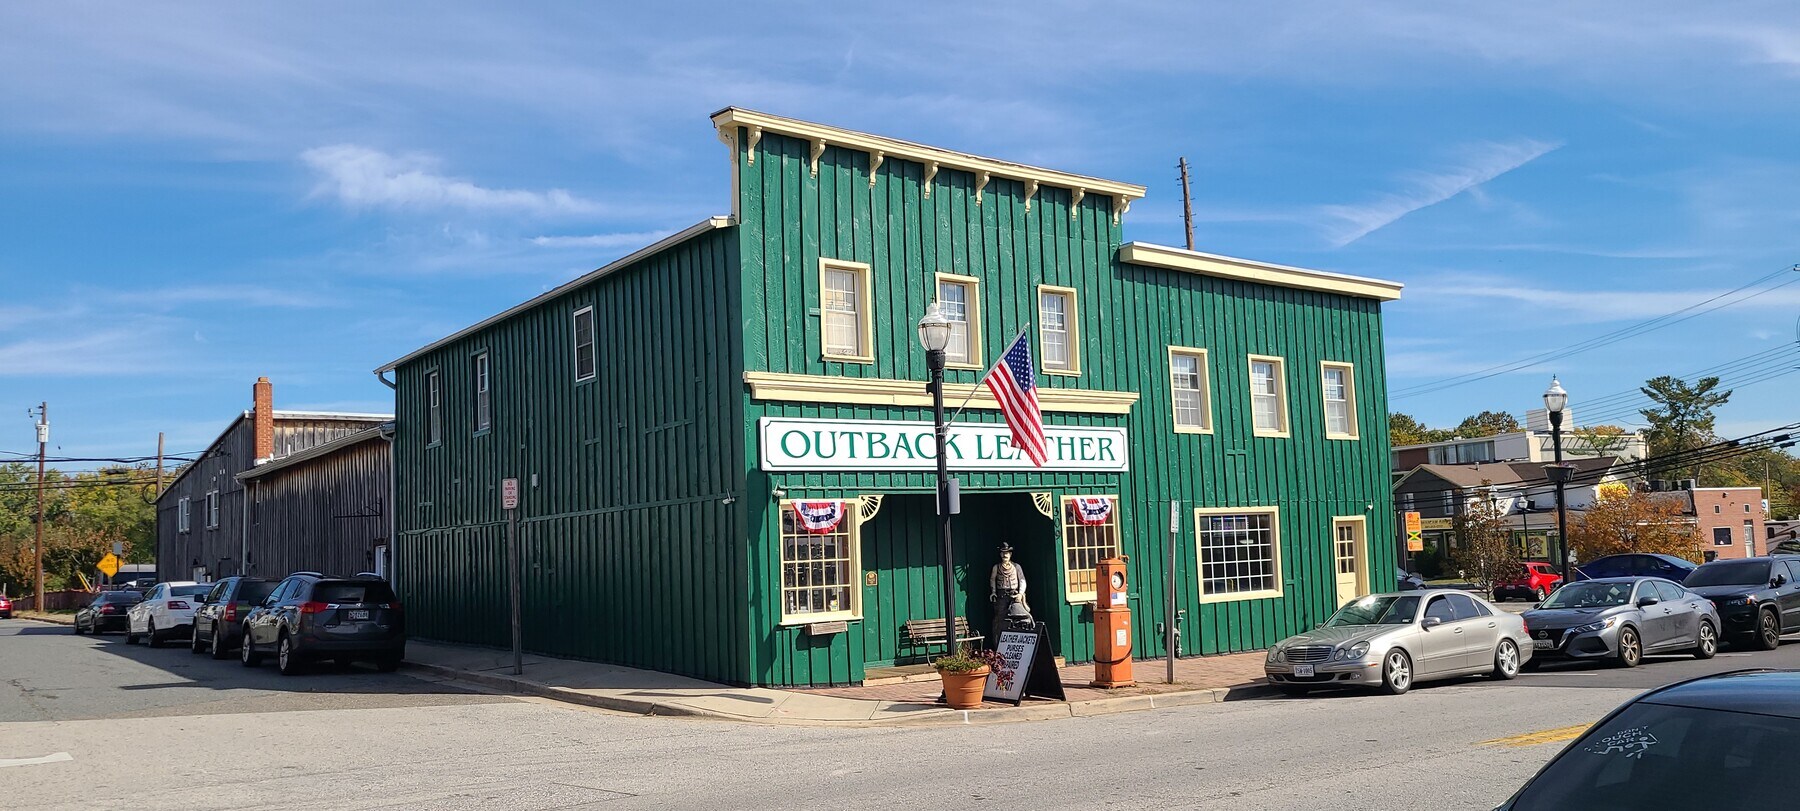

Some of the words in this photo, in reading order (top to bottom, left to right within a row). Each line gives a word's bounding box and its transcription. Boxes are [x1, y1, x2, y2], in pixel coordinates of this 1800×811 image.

[780, 430, 963, 460] OUTBACK
[976, 434, 1116, 462] LEHER
[1001, 635, 1018, 643] LEATHER
[1018, 635, 1036, 645] JACKETS
[1007, 644, 1024, 652] PURSES
[1004, 652, 1022, 660] CLEANED
[1607, 738, 1634, 746] CAR
